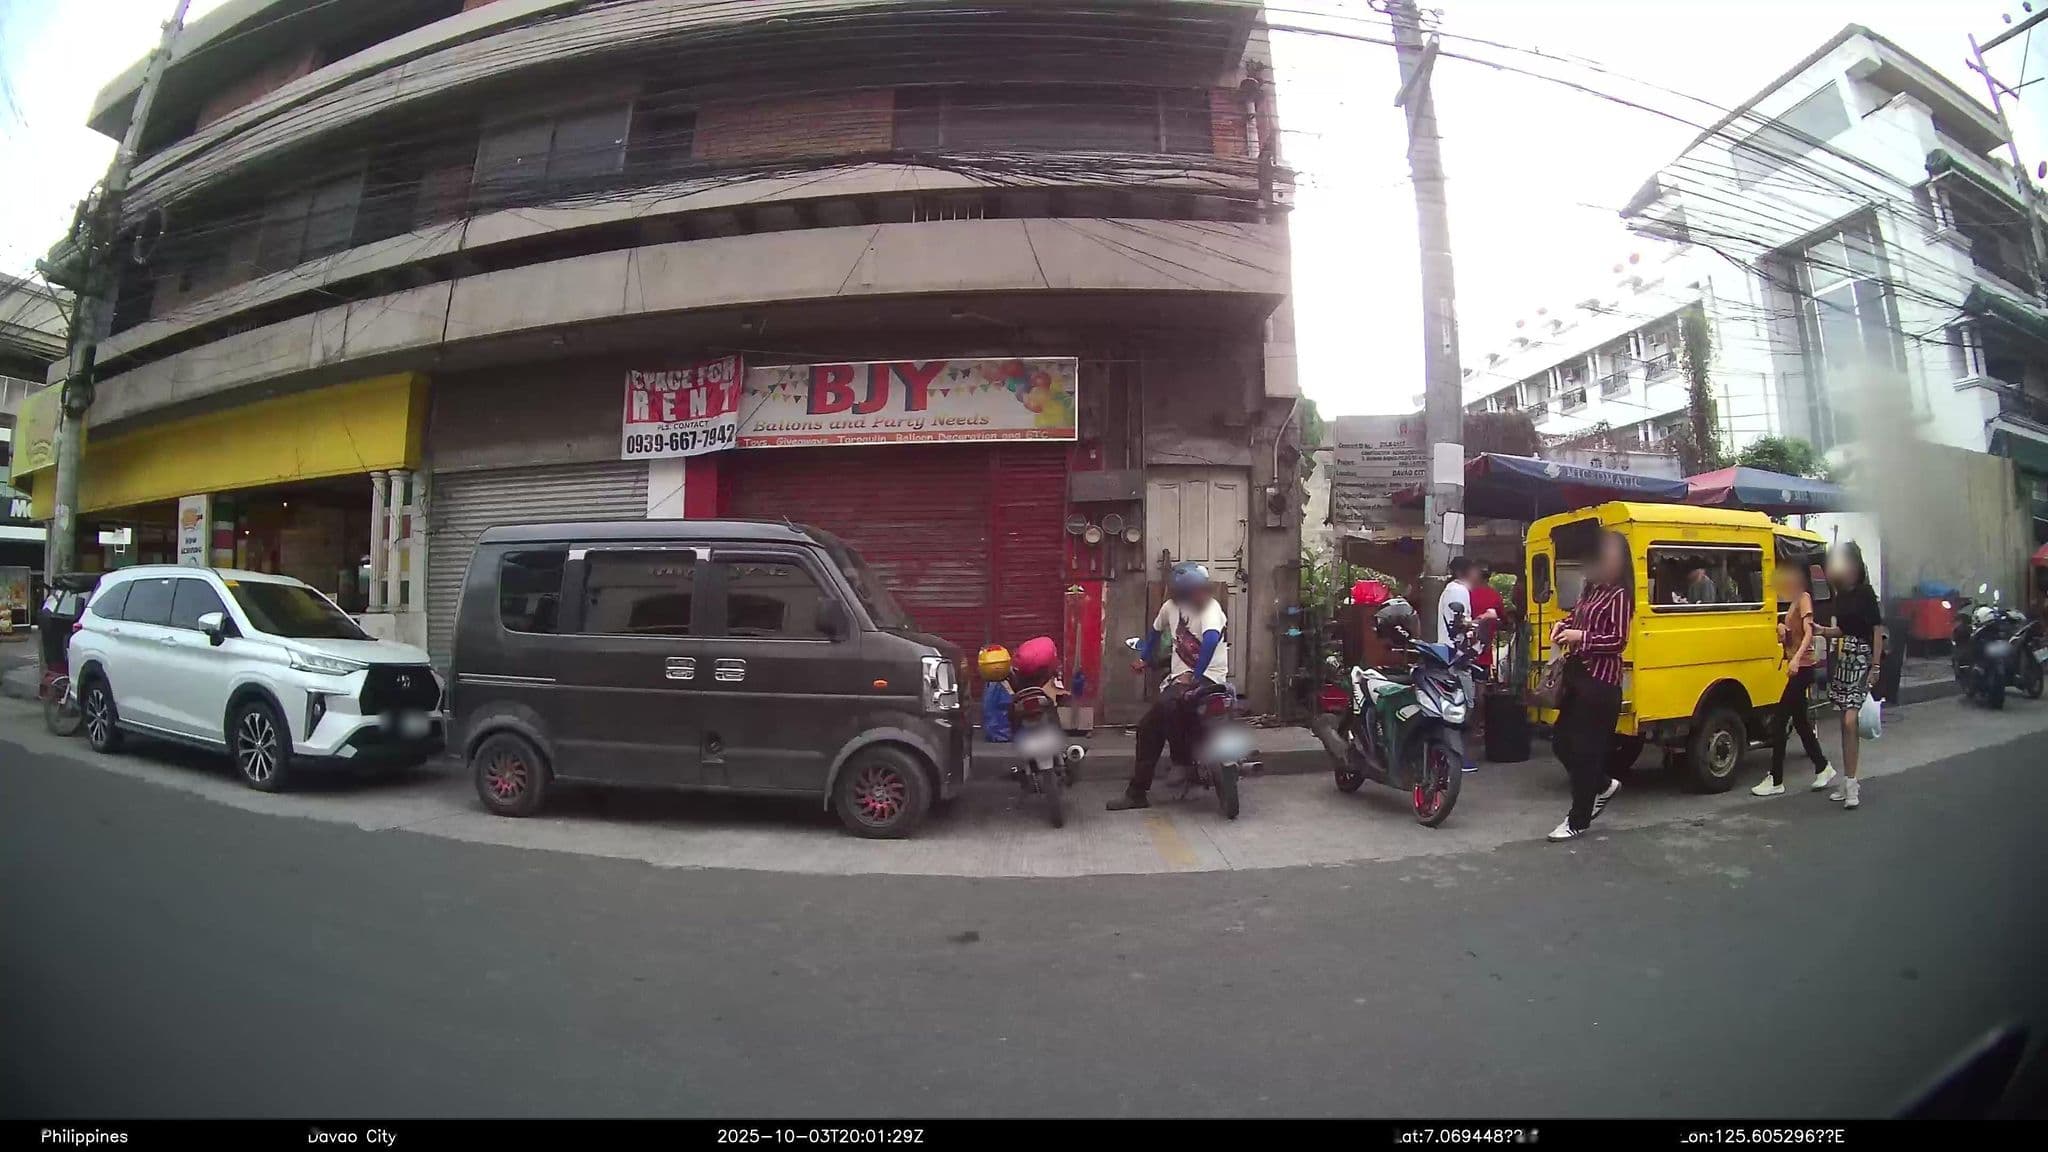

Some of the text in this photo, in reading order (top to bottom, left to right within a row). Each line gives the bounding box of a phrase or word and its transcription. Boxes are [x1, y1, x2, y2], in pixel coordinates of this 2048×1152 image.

[631, 369, 693, 392] SPACE
[806, 361, 947, 415] BJY
[632, 382, 730, 421] RENT
[673, 421, 709, 430] CONTACT
[829, 417, 866, 429] and
[871, 415, 924, 429] Party
[931, 415, 989, 426] Needs
[626, 423, 736, 454] 0939-667-7942
[1002, 431, 1021, 440] and
